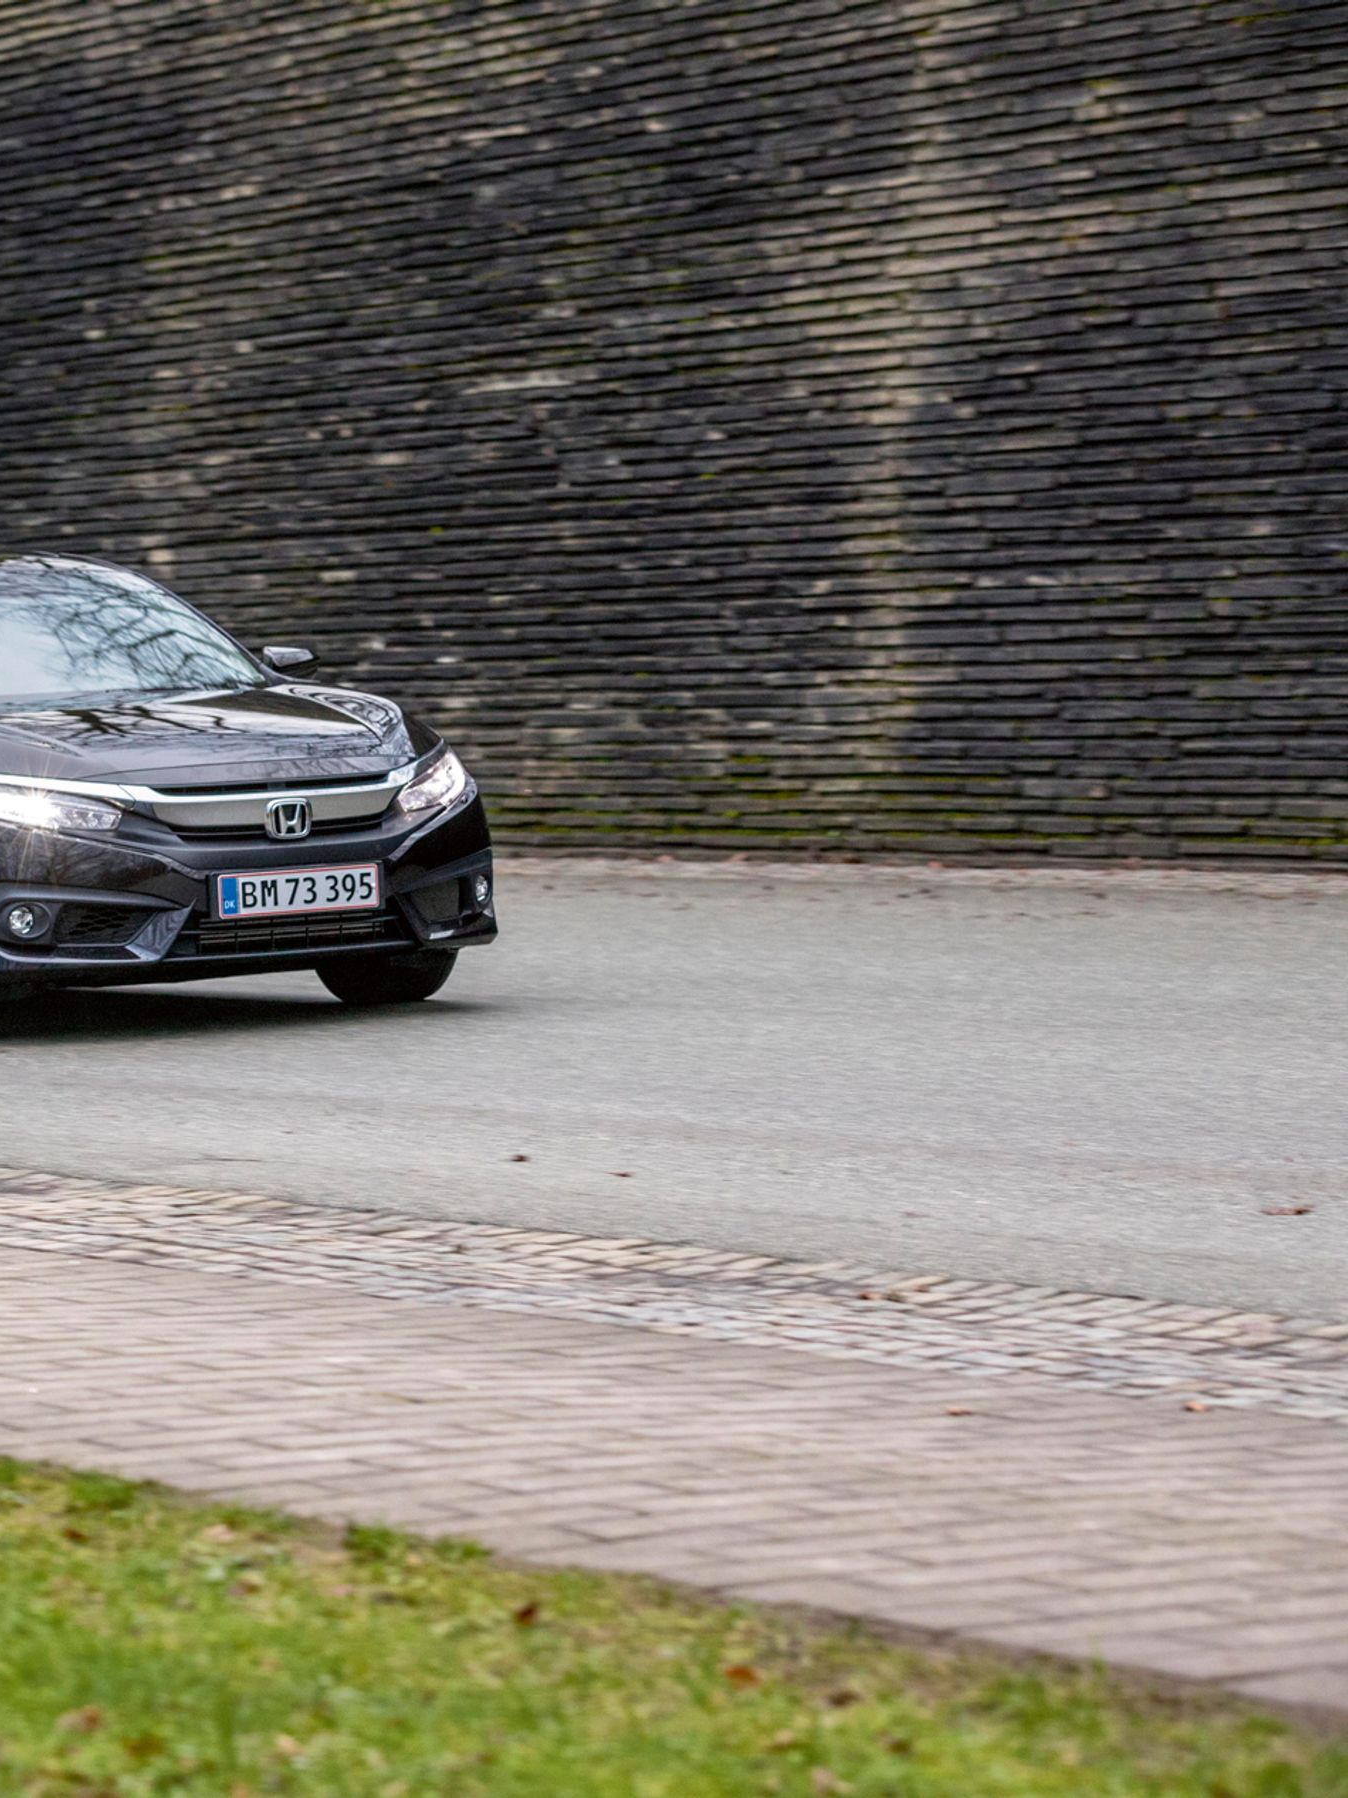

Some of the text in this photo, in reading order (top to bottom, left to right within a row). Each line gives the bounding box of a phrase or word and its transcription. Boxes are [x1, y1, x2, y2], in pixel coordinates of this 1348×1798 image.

[241, 872, 373, 908] BM 73 395
[224, 900, 236, 909] DK
